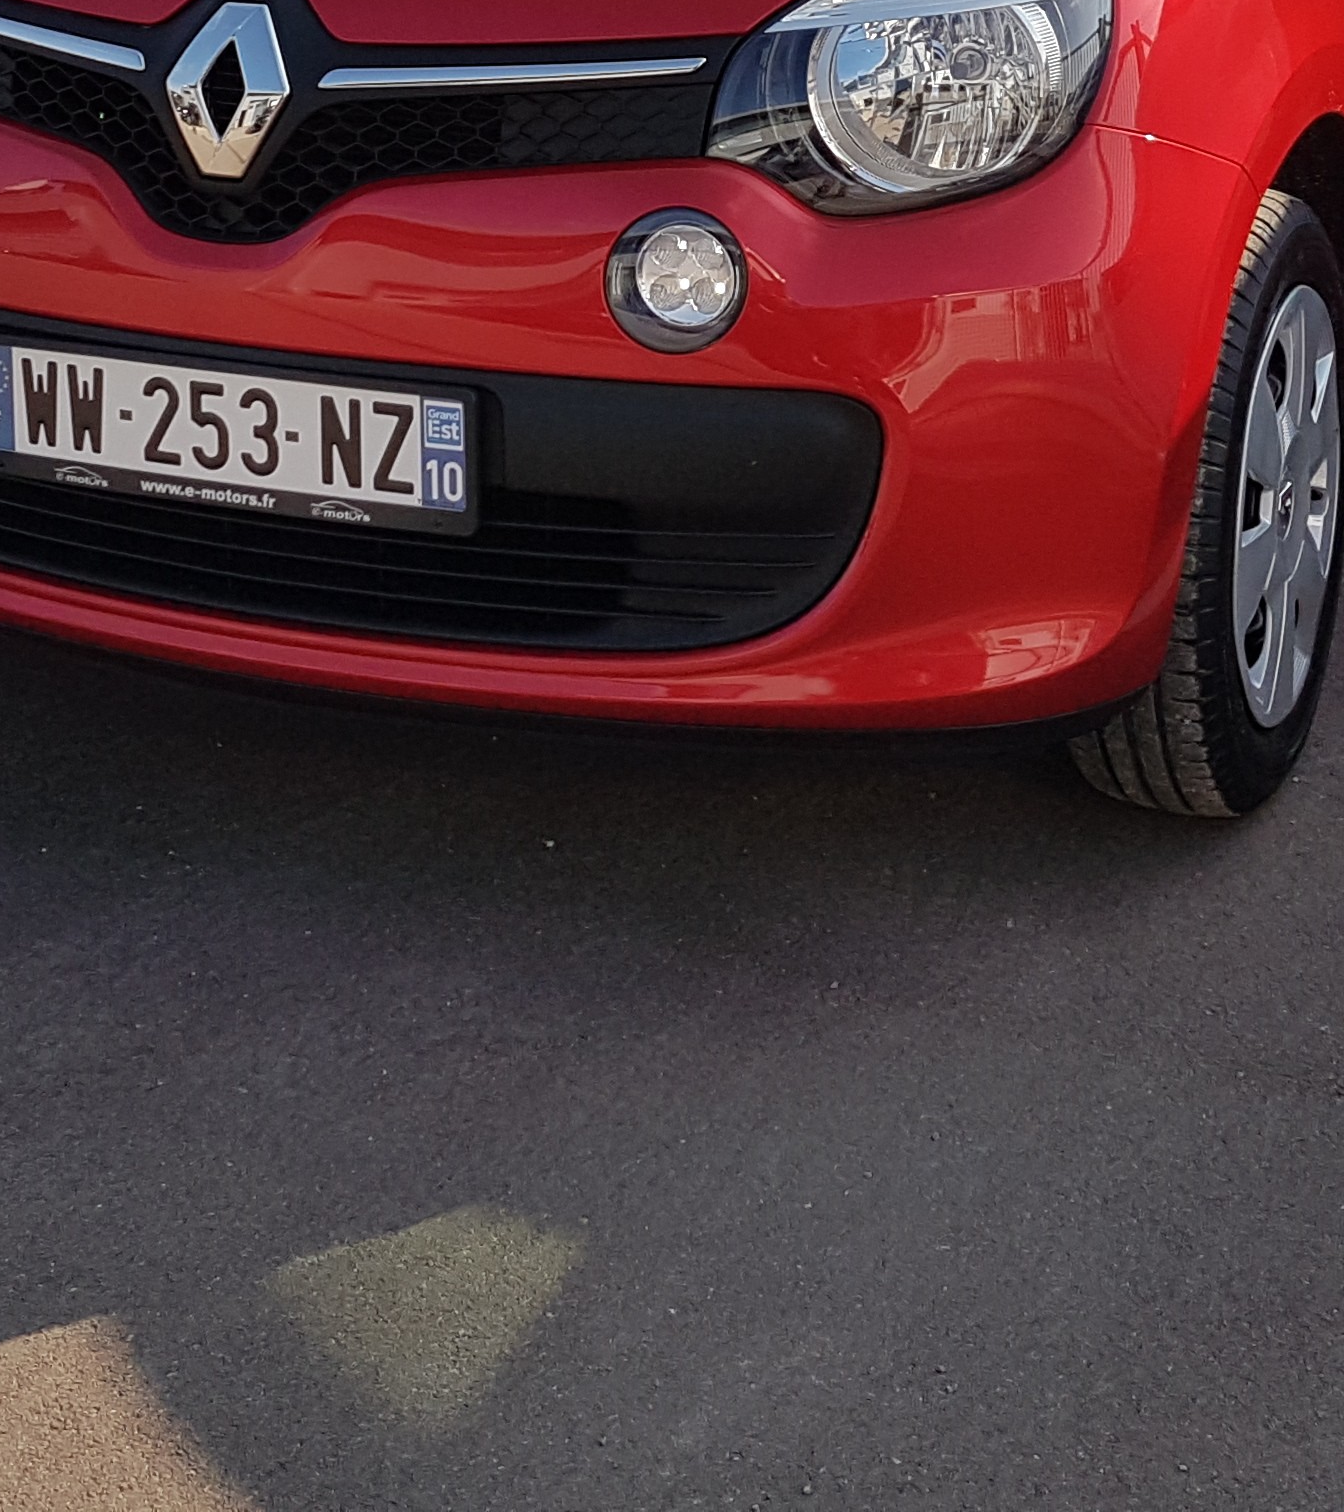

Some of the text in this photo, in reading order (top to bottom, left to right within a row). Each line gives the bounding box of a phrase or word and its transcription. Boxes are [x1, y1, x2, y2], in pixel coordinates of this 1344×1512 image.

[22, 357, 415, 495] WW-253-NZ
[427, 408, 460, 421] Grand
[427, 419, 460, 441] Est
[139, 478, 276, 509] www.e-motors.fr
[425, 458, 464, 502] 10
